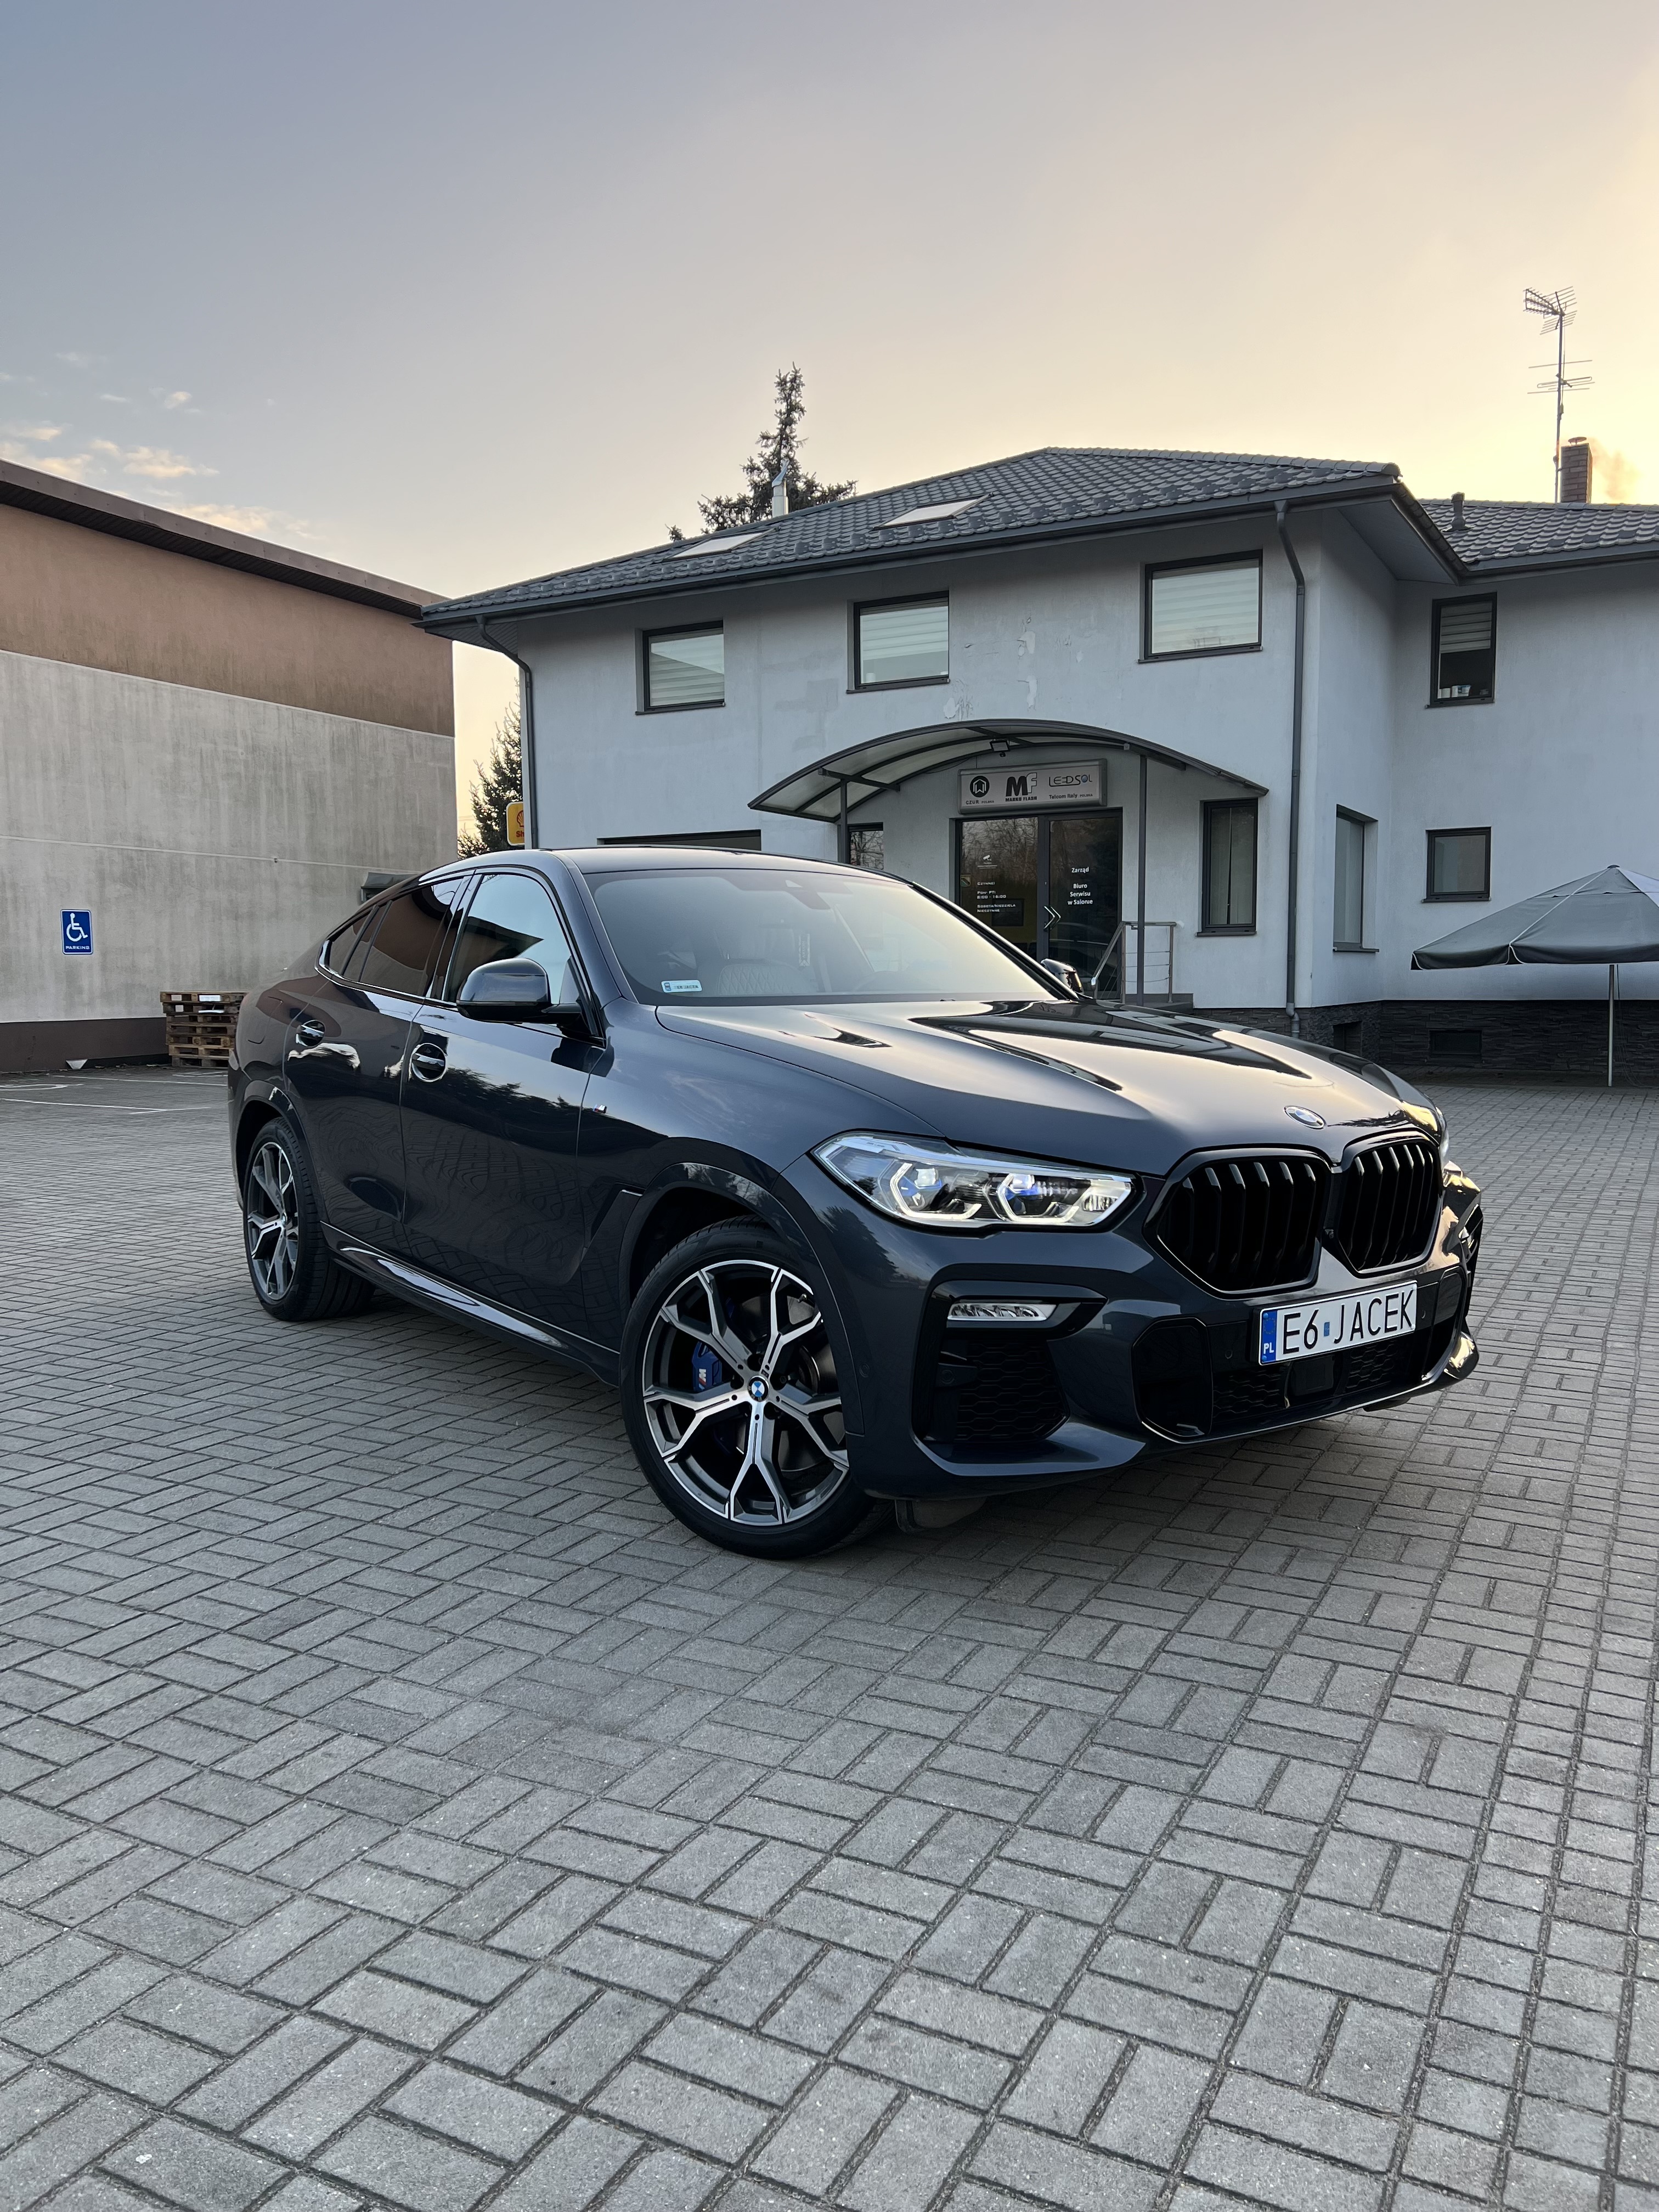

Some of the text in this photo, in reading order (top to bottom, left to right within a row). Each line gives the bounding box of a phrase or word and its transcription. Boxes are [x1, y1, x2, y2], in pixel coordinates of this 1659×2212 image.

[1283, 1290, 1414, 1355] E6 JACEK
[1263, 1342, 1274, 1355] PL
